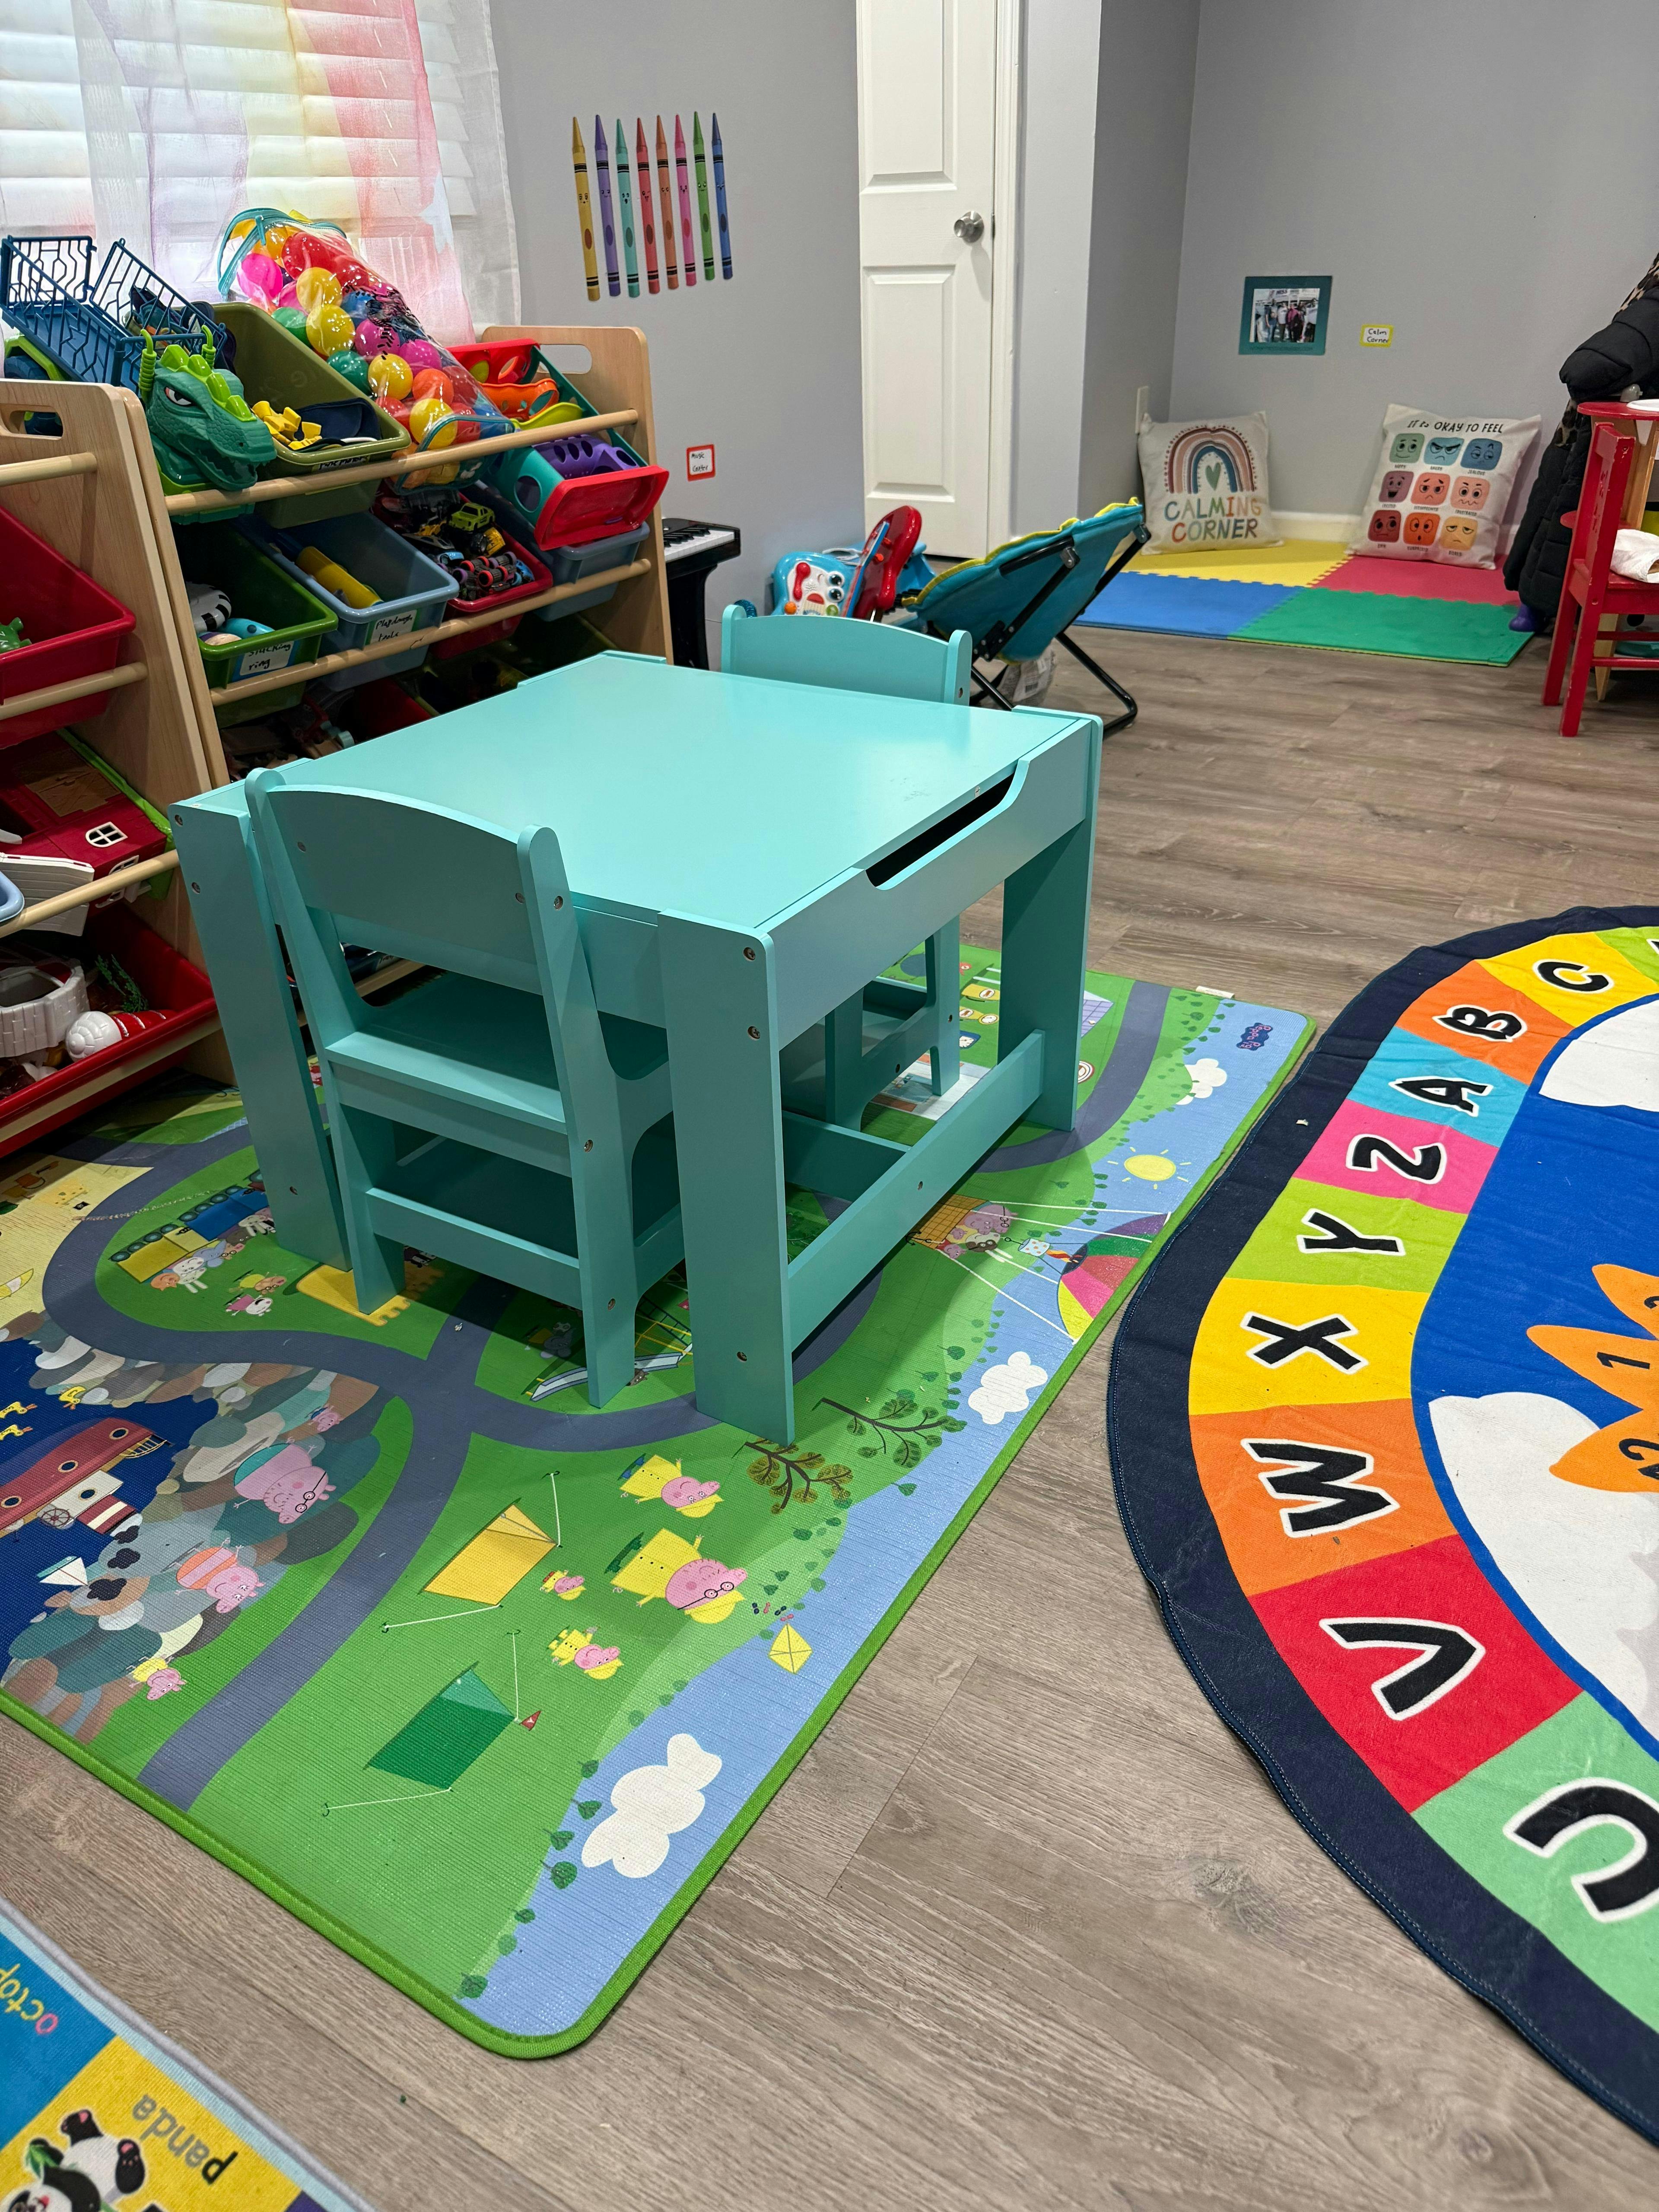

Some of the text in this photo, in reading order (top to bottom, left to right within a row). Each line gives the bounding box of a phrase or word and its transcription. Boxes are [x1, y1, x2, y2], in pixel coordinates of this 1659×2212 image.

[1407, 420, 1420, 428] IT
[1434, 421, 1464, 432] OKAY
[1465, 423, 1479, 432] TO
[1481, 423, 1504, 434] FEEL
[1164, 496, 1262, 521] CALMING
[1172, 518, 1258, 543] CORNER
[249, 659, 270, 670] ring
[1535, 959, 1612, 995] C
[1247, 1024, 1271, 1040] Peppa
[1437, 1004, 1525, 1042] B
[1239, 1041, 1261, 1049] Pig
[1393, 1076, 1491, 1116] A
[1350, 1134, 1444, 1183] Z
[1301, 1209, 1402, 1255] Y
[1244, 1313, 1364, 1373] X
[1597, 1353, 1649, 1369] 1
[1246, 1440, 1394, 1535] W
[1325, 1620, 1479, 1717] V
[1513, 1784, 1659, 1915] U
[133, 2094, 238, 2185] panda
